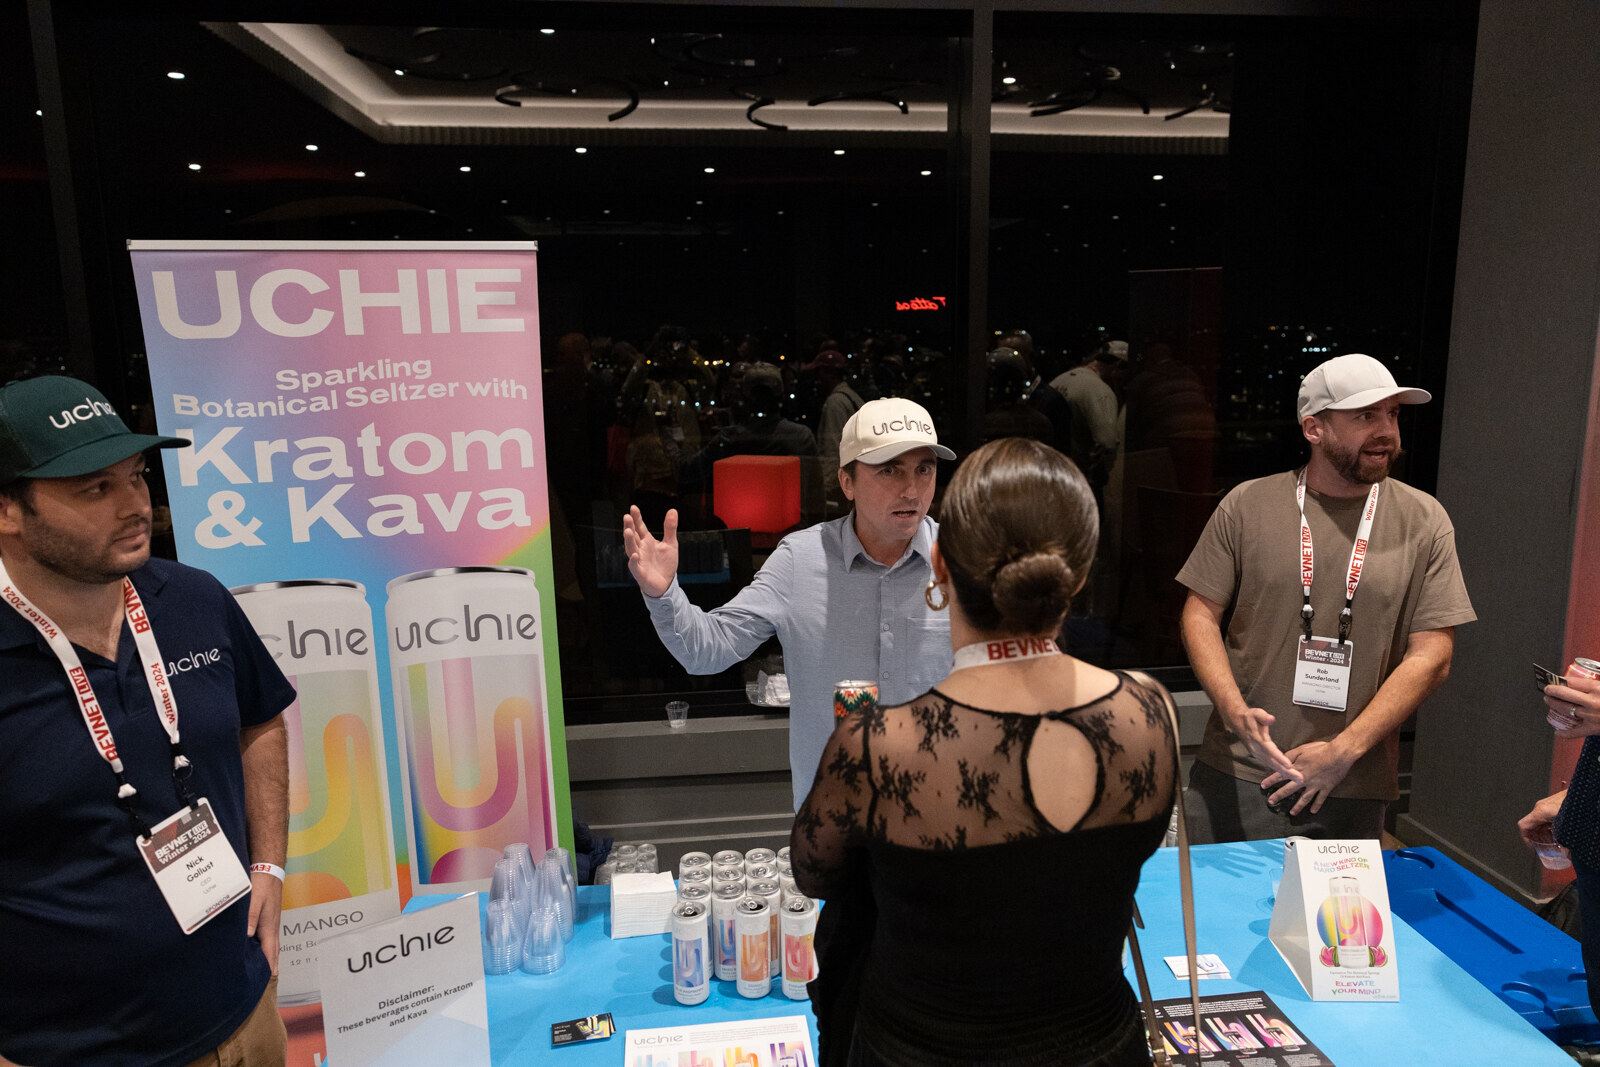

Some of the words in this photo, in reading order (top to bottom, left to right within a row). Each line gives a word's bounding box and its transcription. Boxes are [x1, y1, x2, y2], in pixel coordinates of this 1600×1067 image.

[152, 268, 525, 340] UCHIE
[275, 358, 432, 393] Sparkling
[173, 389, 338, 418] Botanical
[345, 381, 459, 408] Seltzer
[465, 377, 528, 400] with
[872, 415, 932, 436] uchie
[175, 422, 534, 487] Kratom
[194, 489, 267, 550] &
[287, 483, 532, 544] Kava
[3, 585, 27, 609] 2024
[24, 607, 58, 640] Winter
[395, 604, 536, 652] uchie
[1305, 649, 1332, 658] BEVNET
[151, 662, 166, 687] 2024
[160, 688, 176, 725] Winter
[154, 830, 195, 859] BEVNET
[159, 843, 189, 865] Winter
[192, 828, 212, 845] 2024
[186, 855, 204, 870] Nick
[187, 861, 214, 882] Gollust
[283, 910, 364, 937] MANGO
[347, 926, 455, 973] uchie
[337, 1019, 364, 1034] These
[365, 1004, 410, 1024] beverages
[410, 992, 442, 1008] contain
[443, 981, 473, 996] Kratom
[378, 984, 435, 1010] Disclaimer:
[389, 1015, 406, 1027] and
[407, 1009, 428, 1021] Kava
